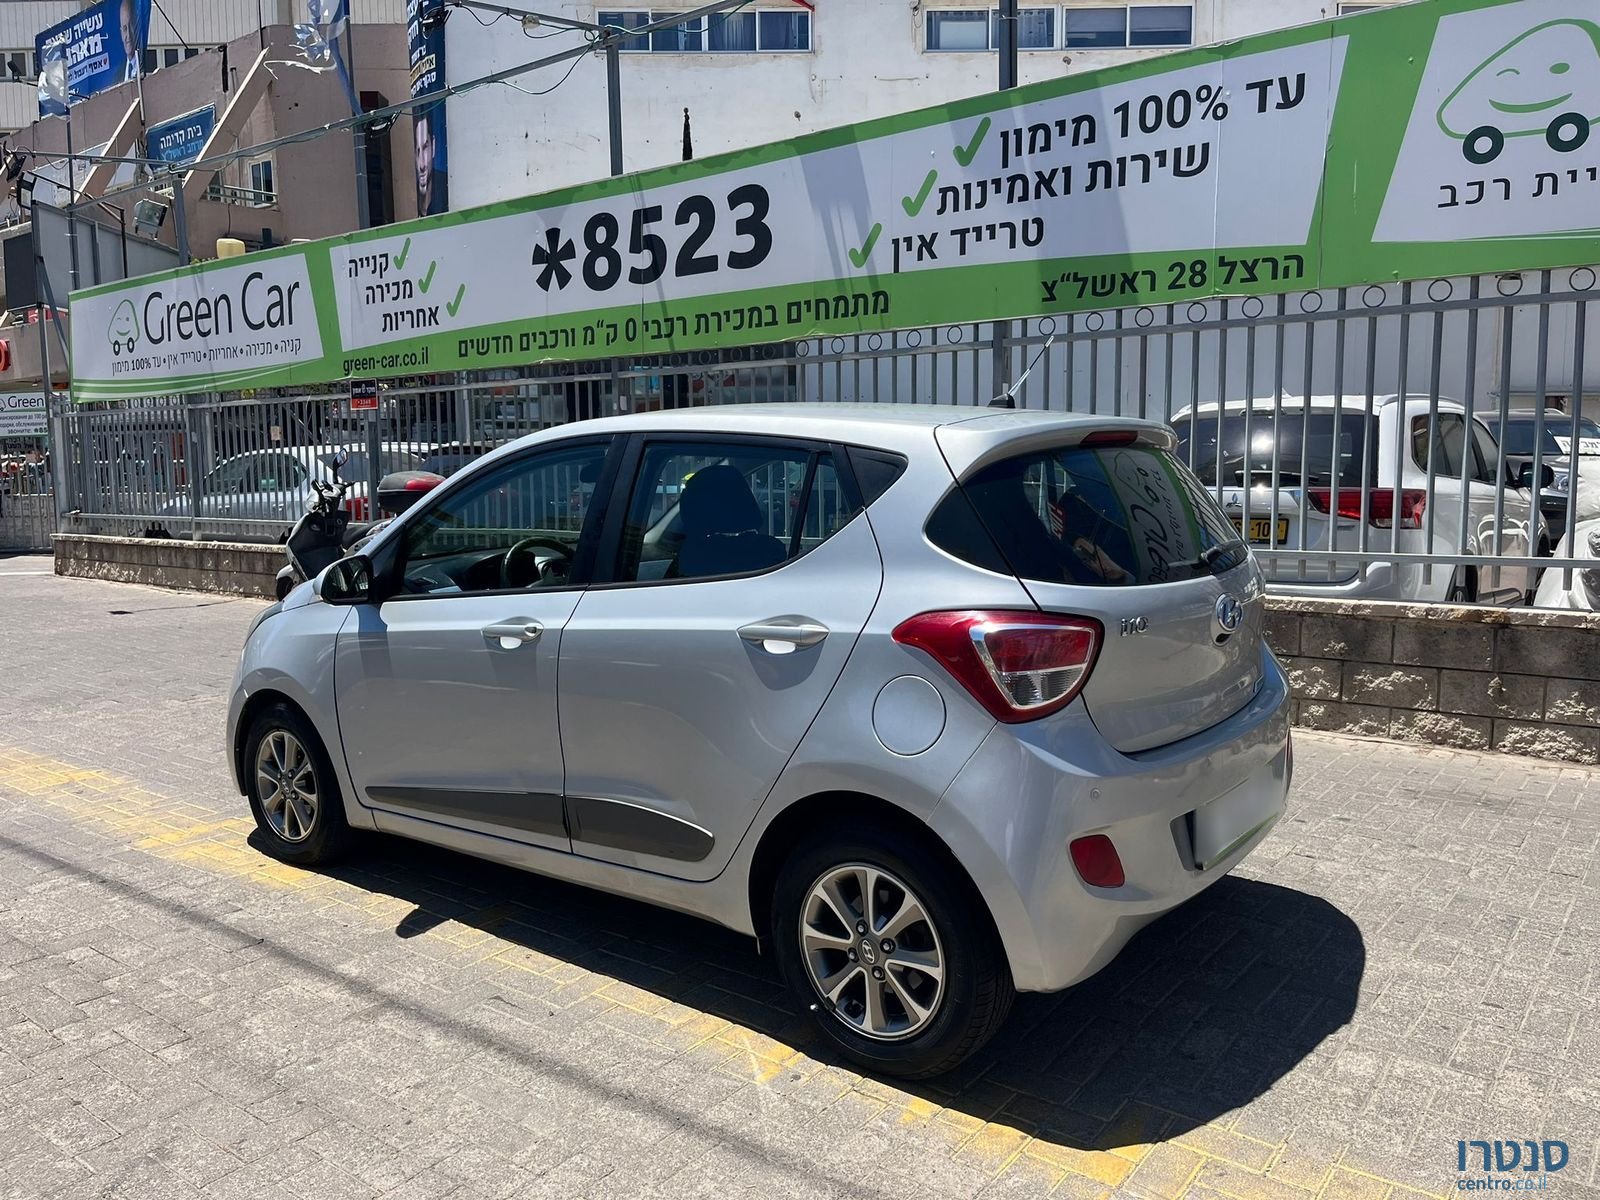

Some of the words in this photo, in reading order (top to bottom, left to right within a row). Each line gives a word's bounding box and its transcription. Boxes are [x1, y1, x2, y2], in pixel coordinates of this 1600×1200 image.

[1246, 73, 1306, 114] עד
[1113, 84, 1229, 139] 100%
[160, 130, 185, 149] קדימה
[187, 124, 203, 140] בית
[999, 114, 1097, 168] מימון
[1085, 141, 1210, 193] שירות
[936, 164, 1071, 216] ואמינות
[1438, 177, 1511, 208] רכב
[950, 216, 1044, 256] טרייד
[891, 231, 938, 273] אין
[348, 253, 389, 279] קנייה
[1167, 259, 1207, 290] 28
[1218, 254, 1304, 285] הרצל
[365, 279, 413, 305] מכירה
[144, 291, 233, 345] Green
[241, 271, 300, 331] Car
[382, 306, 440, 333] אחריות
[695, 303, 779, 333] במכירת
[786, 289, 890, 325] מתמחים
[519, 327, 576, 352] ורכבים
[625, 319, 637, 342] 0
[643, 315, 687, 341] רכבי
[182, 350, 201, 364] טרייד
[208, 345, 239, 361] אחריות
[245, 341, 273, 357] מכירה
[280, 338, 301, 356] קניה
[457, 335, 513, 358] חדשים
[112, 360, 129, 376] מימון
[131, 357, 151, 370] 100%
[152, 356, 161, 368] עד
[167, 353, 179, 370] אין
[343, 346, 429, 376] green-car.co.il
[8, 396, 44, 408] Green
[1120, 616, 1148, 637] i10
